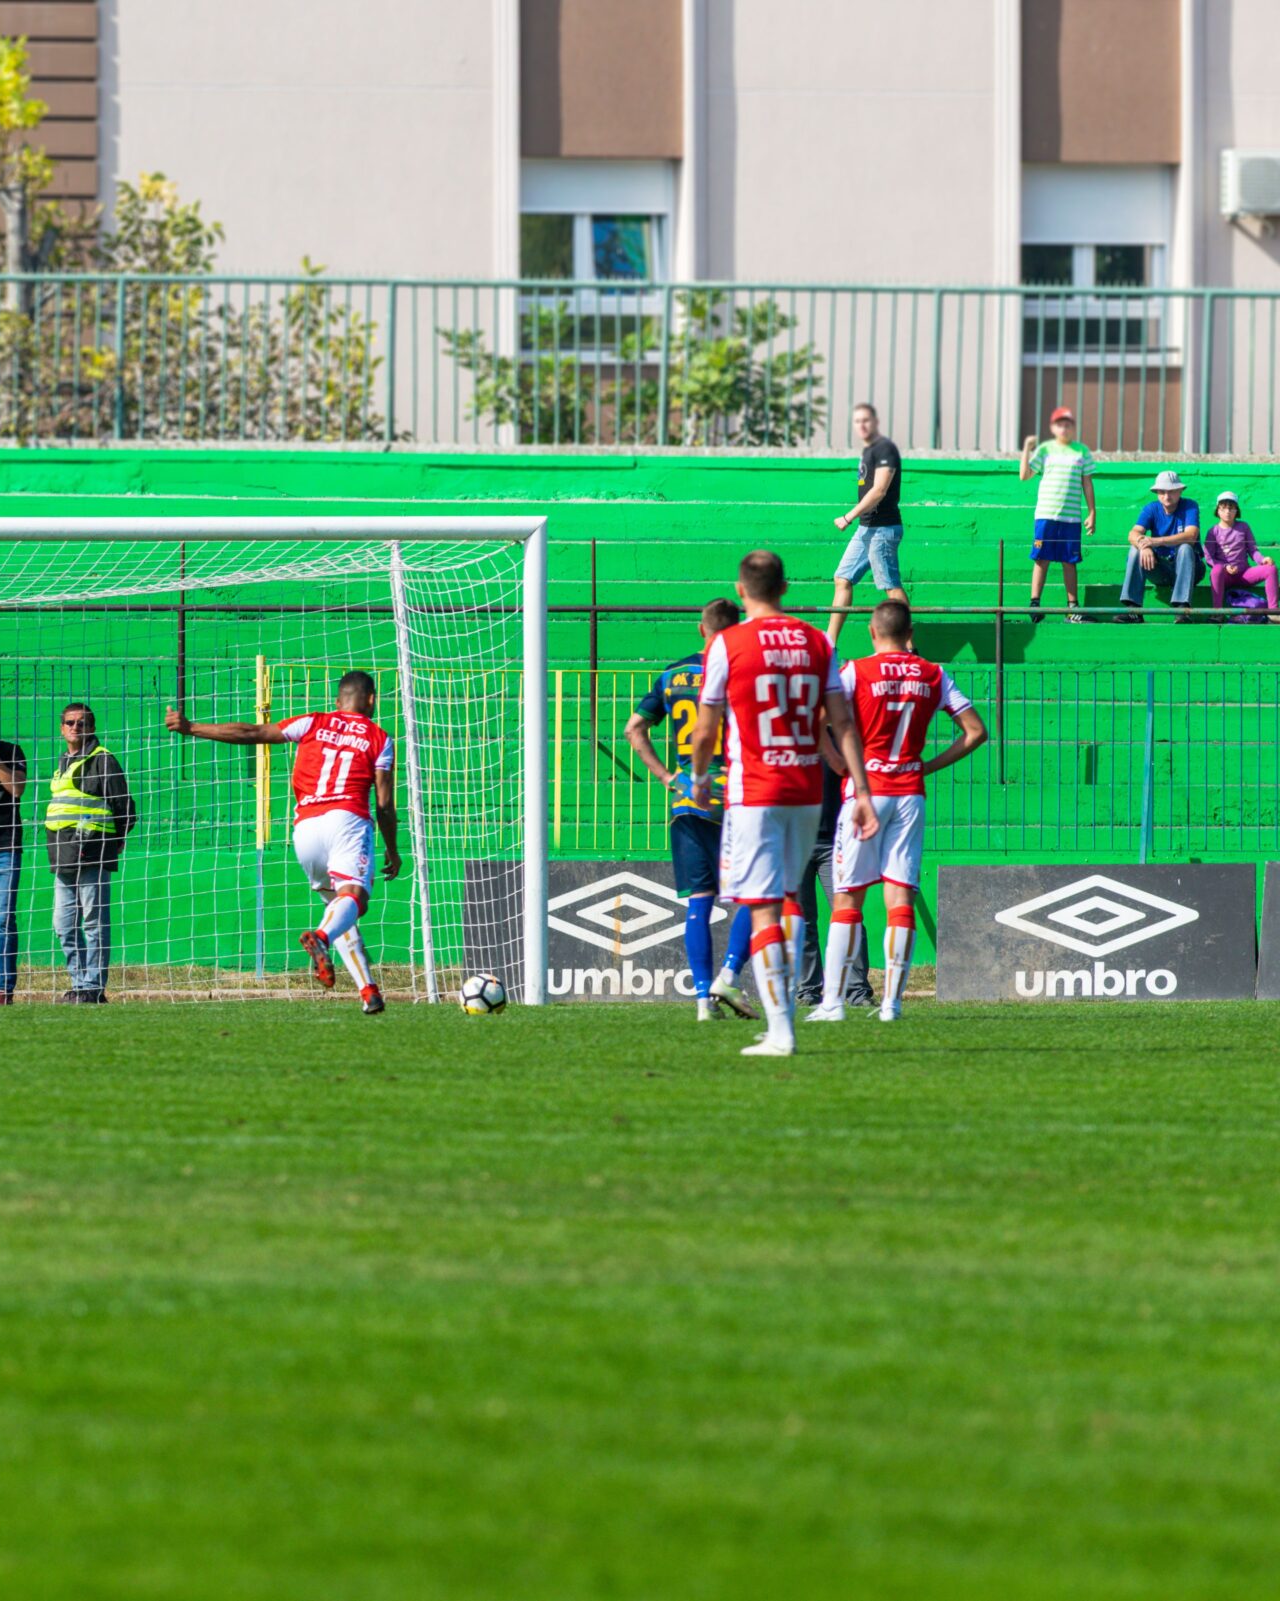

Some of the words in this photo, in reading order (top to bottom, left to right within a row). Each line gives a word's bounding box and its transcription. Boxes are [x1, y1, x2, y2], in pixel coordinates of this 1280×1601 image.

[758, 626, 808, 647] mts
[880, 661, 922, 677] mts
[329, 716, 368, 734] mts
[755, 673, 820, 748] 23
[886, 701, 916, 762] 7
[315, 747, 355, 797] 11
[547, 960, 699, 997] umbro
[1015, 961, 1178, 998] umbro
